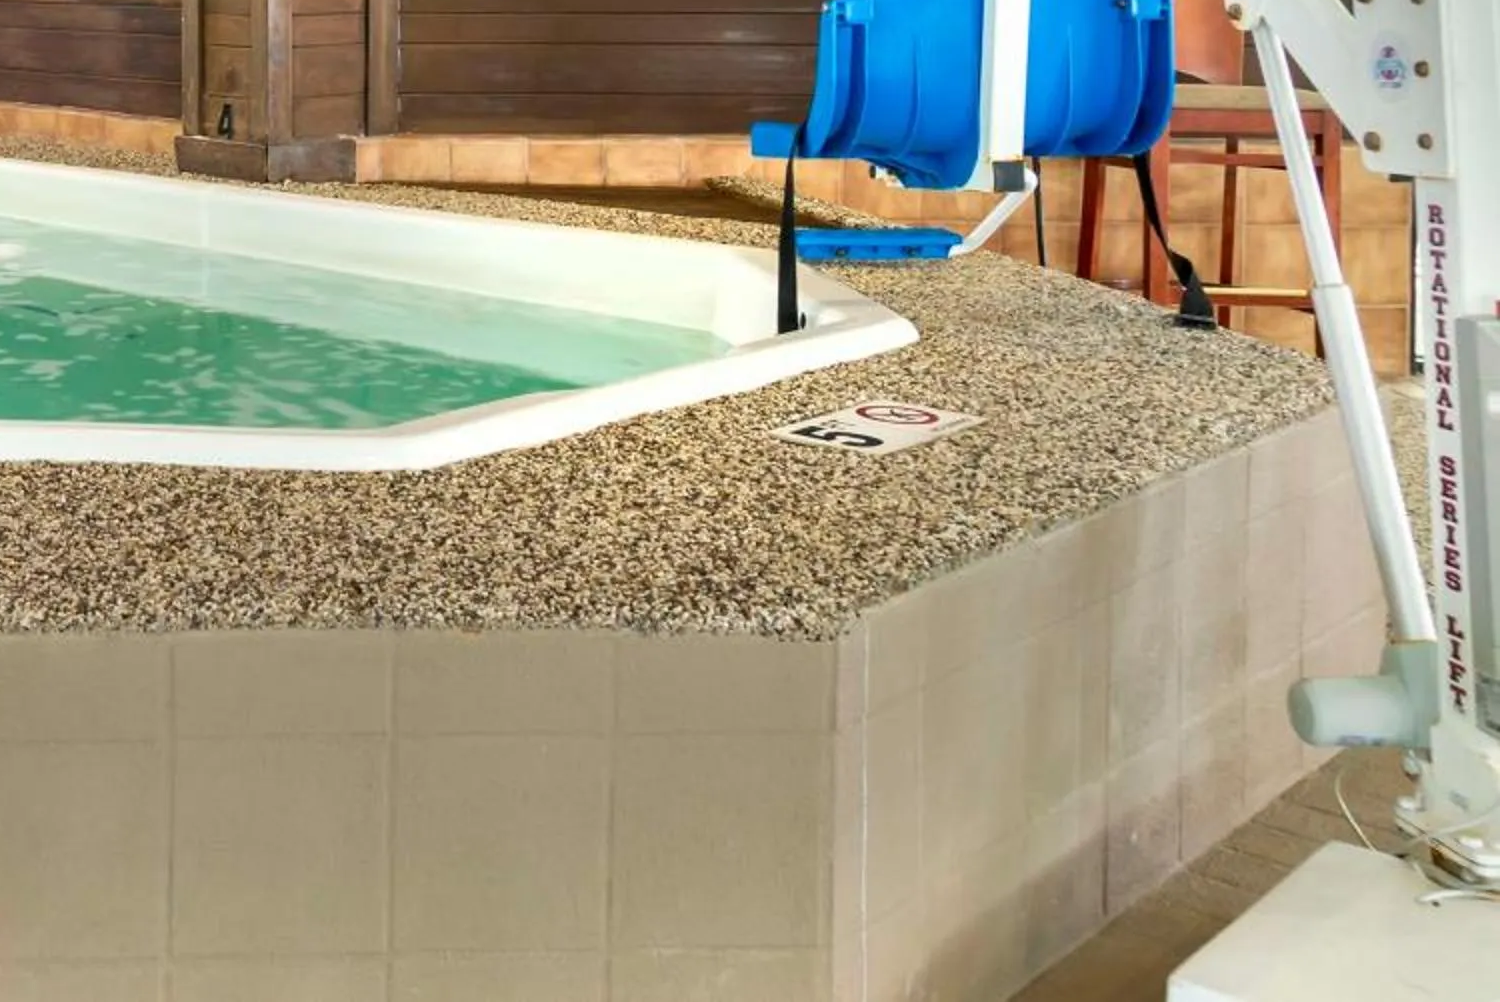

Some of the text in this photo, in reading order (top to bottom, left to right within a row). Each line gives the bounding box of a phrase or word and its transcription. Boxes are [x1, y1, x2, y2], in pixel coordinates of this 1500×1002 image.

[789, 425, 884, 447] 5
[1427, 204, 1467, 716] ROTATIONAL SERIES LIFT
